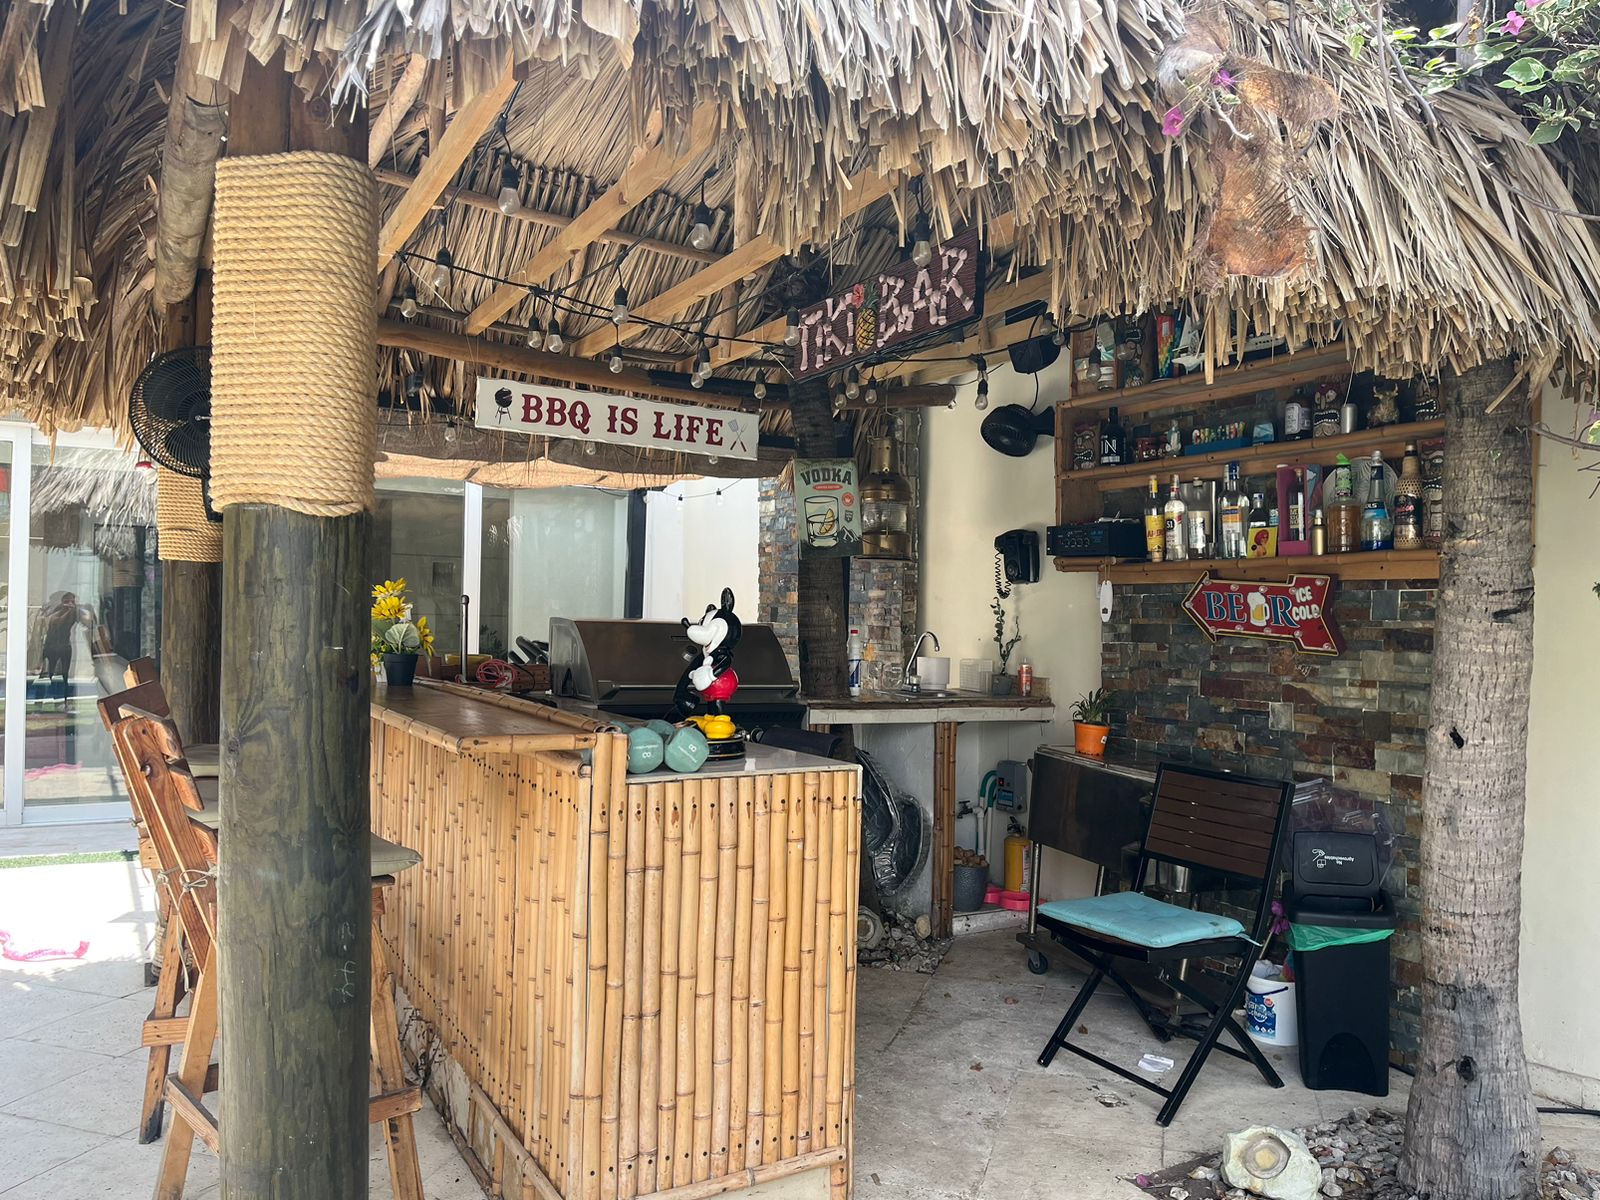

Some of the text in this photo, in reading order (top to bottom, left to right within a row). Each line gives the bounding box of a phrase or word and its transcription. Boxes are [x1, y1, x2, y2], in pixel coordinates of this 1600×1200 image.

[800, 247, 974, 371] TIKI BAR
[521, 393, 724, 446] BBQ IS LIFE
[800, 468, 852, 486] VODKA
[1295, 586, 1313, 602] ICE
[1202, 590, 1300, 628] BER
[642, 751, 651, 759] 8
[688, 743, 697, 753] 8
